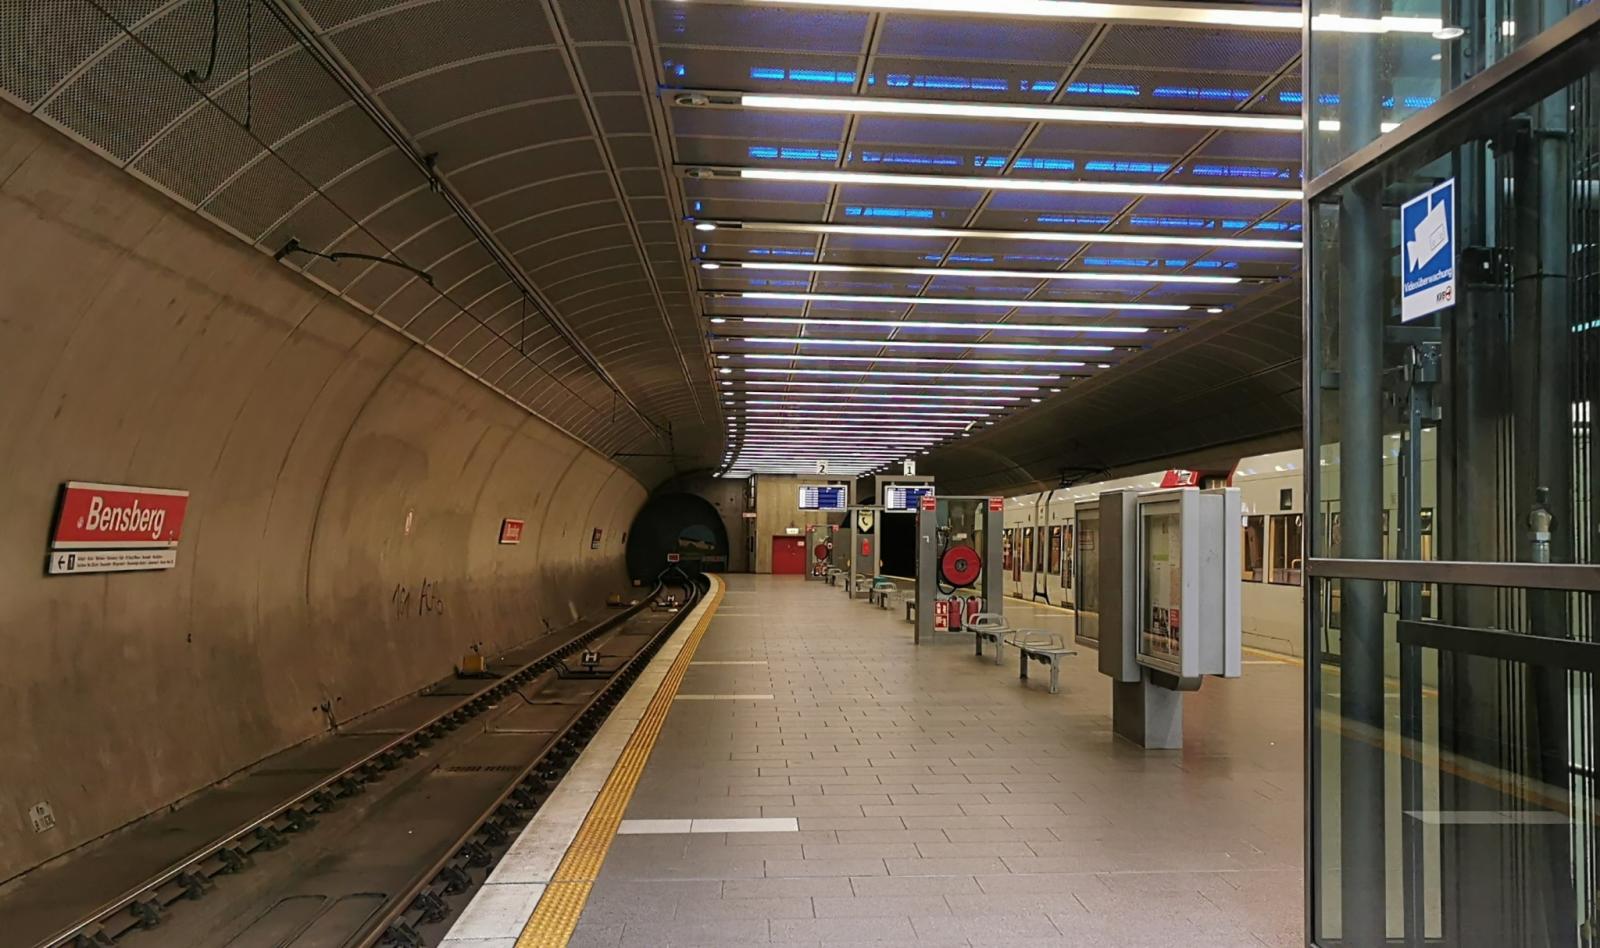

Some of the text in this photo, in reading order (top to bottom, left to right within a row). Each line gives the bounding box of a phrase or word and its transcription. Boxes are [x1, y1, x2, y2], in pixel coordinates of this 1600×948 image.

[1404, 267, 1453, 292] Videoüberwachung
[819, 464, 825, 473] 2
[907, 465, 912, 475] 1
[86, 496, 166, 540] Bensberg
[68, 555, 75, 570] 1
[585, 652, 597, 662] H
